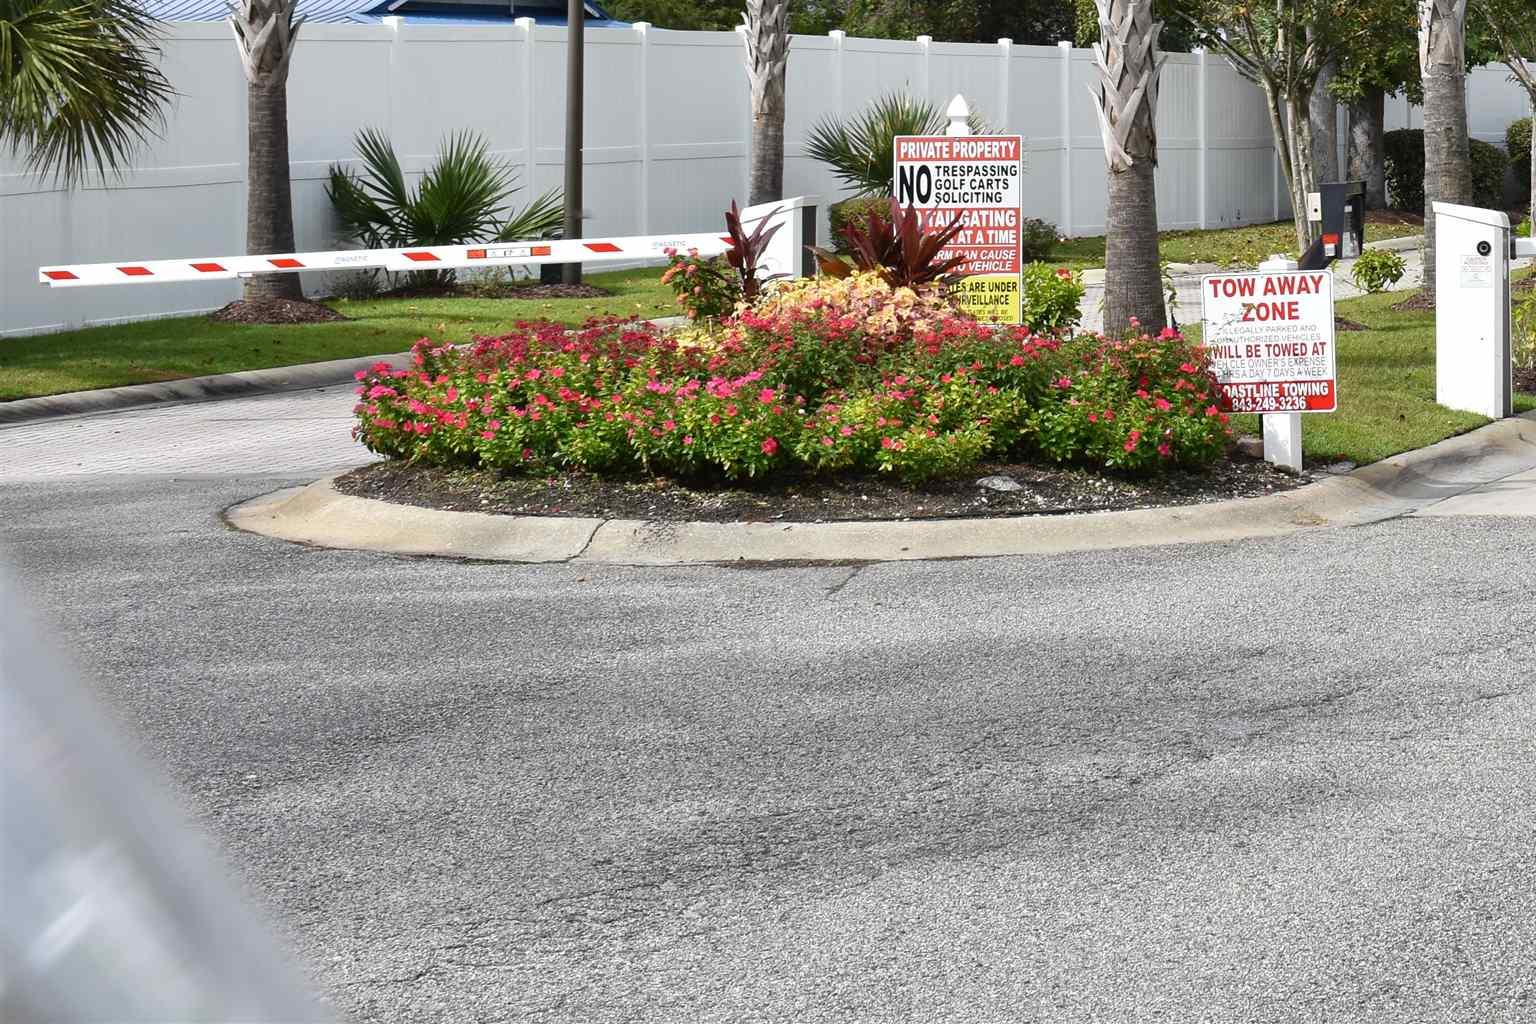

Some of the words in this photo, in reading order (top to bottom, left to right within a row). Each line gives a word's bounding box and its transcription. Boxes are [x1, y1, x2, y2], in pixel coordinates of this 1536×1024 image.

[900, 141, 950, 158] PRIVATE
[952, 141, 1016, 158] PROPERTY
[935, 165, 1018, 177] TRESPASSING
[899, 164, 932, 204] NO
[935, 178, 966, 190] GOLF
[969, 178, 1009, 190] CARTS
[935, 191, 1003, 204] SOLICITING
[957, 230, 973, 244] AT
[975, 230, 985, 244] A
[985, 230, 1017, 244] TIME
[981, 250, 1017, 260] CAUSE
[969, 260, 1012, 272] VEHICLE
[969, 281, 986, 293] ARE
[988, 281, 1018, 293] UNDER
[1208, 277, 1256, 298] TOW
[1263, 274, 1324, 296] AWAY
[1241, 300, 1300, 322] ZONE
[1265, 325, 1298, 334] PARKED
[1299, 324, 1317, 332] AND
[1281, 333, 1321, 341] VEHICLES
[1212, 344, 1242, 359] WILL
[1246, 344, 1262, 359] BE
[1265, 342, 1308, 358] TOWED
[1311, 342, 1327, 356] AT
[1287, 356, 1326, 367] EXPENSE
[1273, 367, 1295, 377] DAYS
[1304, 366, 1328, 376] WEEK
[1282, 382, 1329, 396] TOWING
[1232, 396, 1307, 411] 843-249-3236
